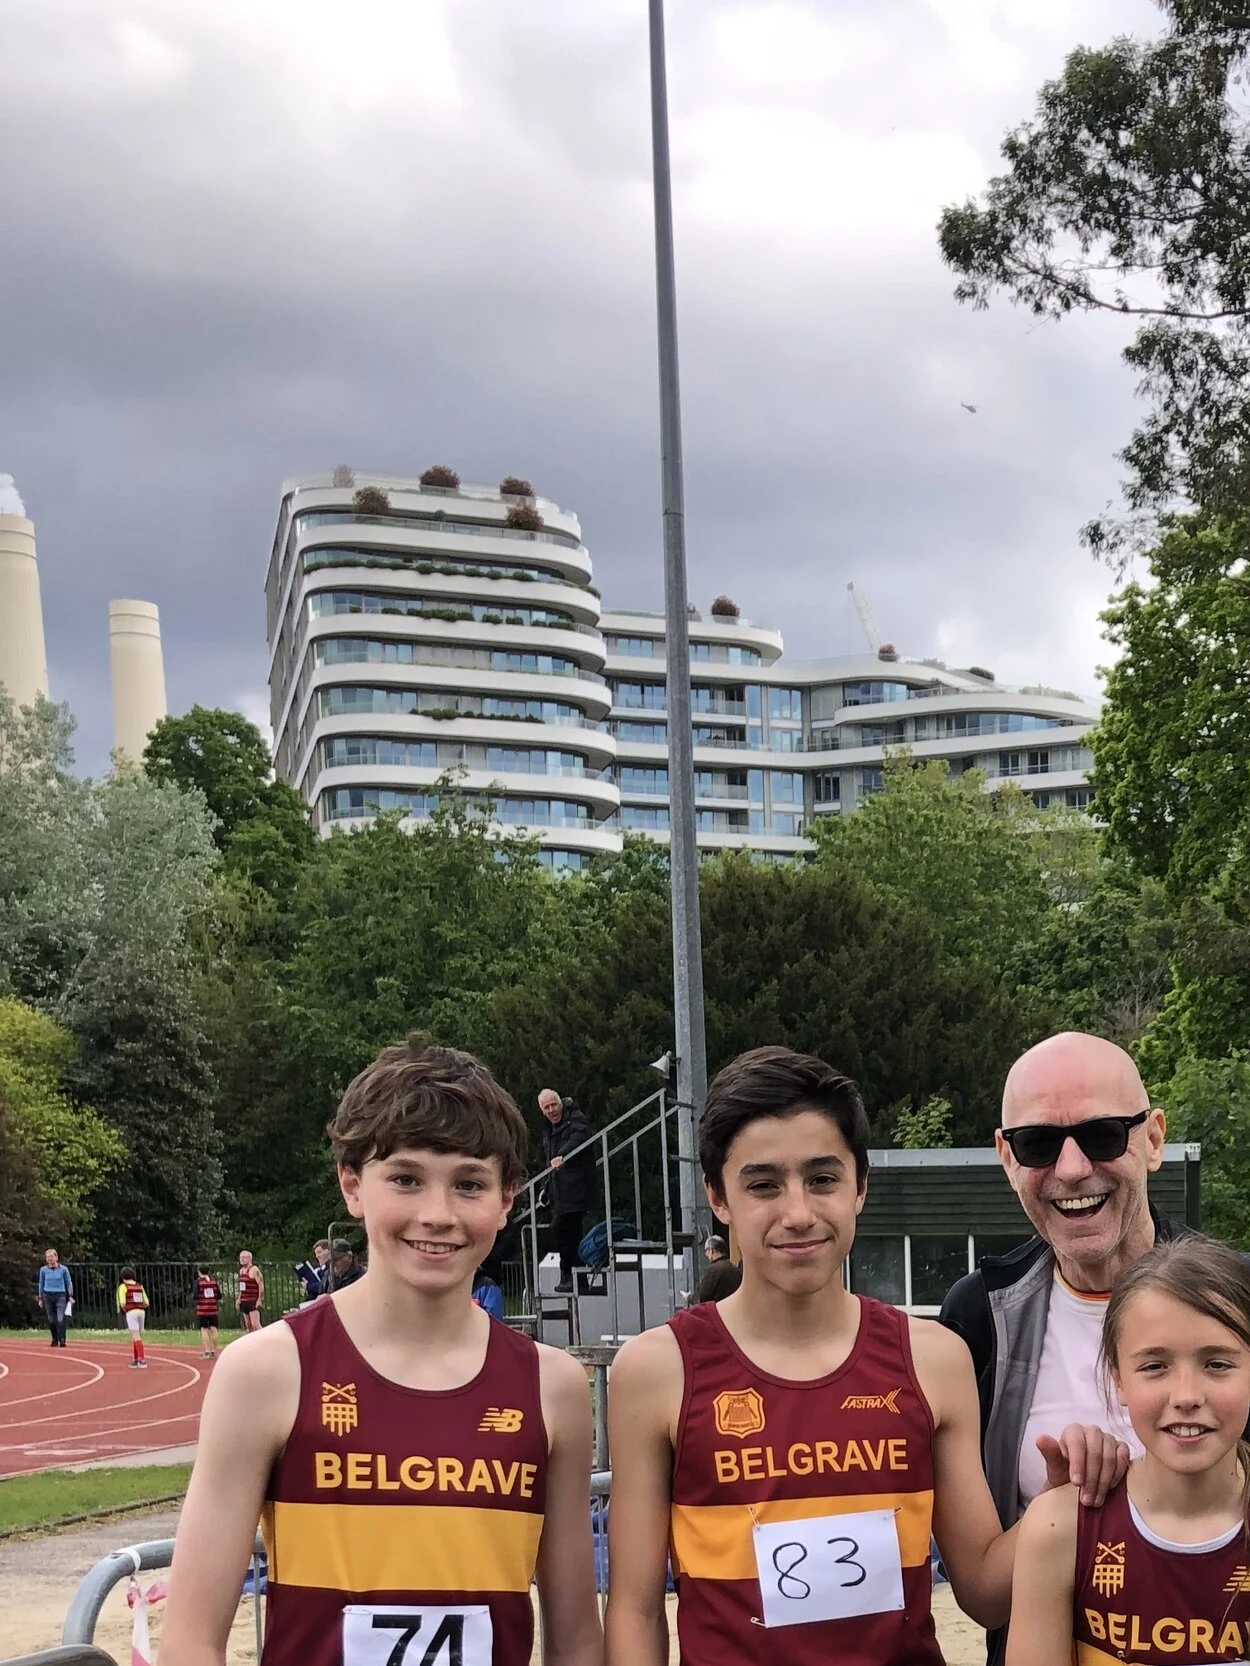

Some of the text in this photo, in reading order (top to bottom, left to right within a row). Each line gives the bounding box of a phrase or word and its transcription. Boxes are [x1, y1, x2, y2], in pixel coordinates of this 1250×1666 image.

[315, 1452, 538, 1498] BELGRAVE
[714, 1439, 909, 1484] BELGRAVE
[773, 1537, 866, 1599] 83
[1084, 1608, 1250, 1655] BELGRA
